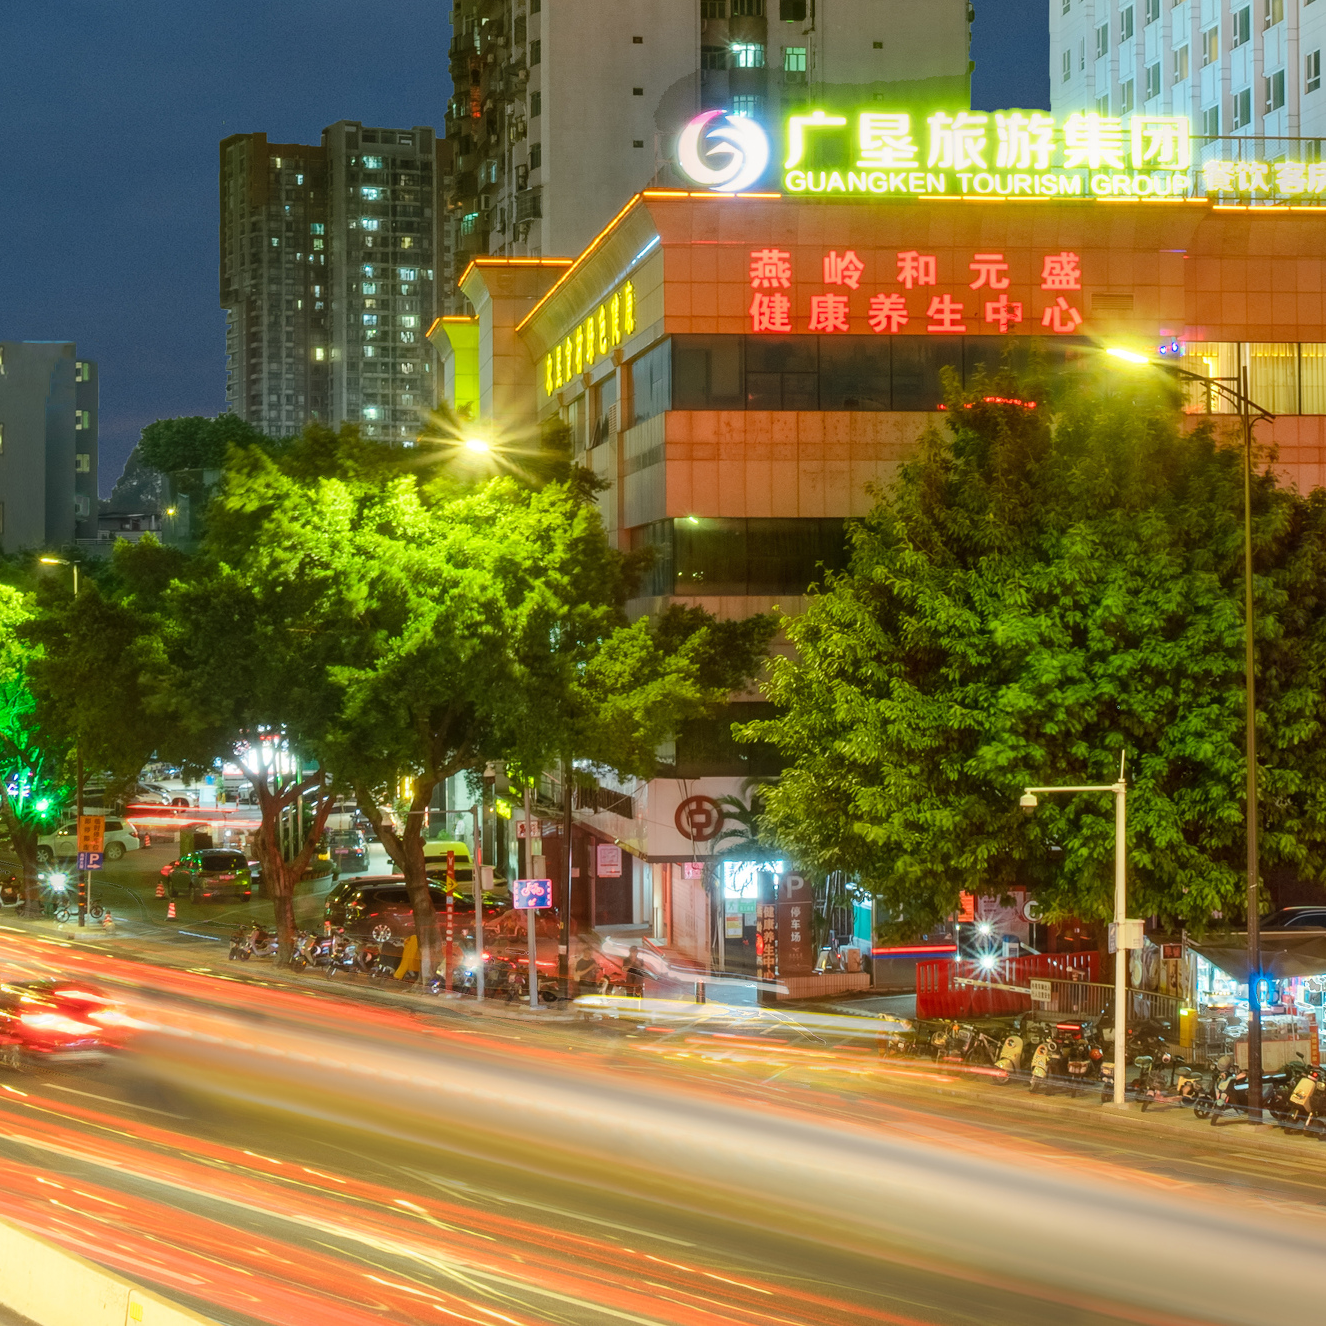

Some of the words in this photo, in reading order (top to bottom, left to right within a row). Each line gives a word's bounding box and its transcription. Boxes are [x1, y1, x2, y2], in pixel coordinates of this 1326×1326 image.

[784, 110, 1190, 170] 广垦旅游集团
[784, 171, 947, 193] GUANGKEN
[956, 172, 1081, 195] TOURISM
[1090, 173, 1191, 197] GROUP
[1203, 160, 1270, 193] 餐饮
[749, 249, 1082, 290] 燕岭和元盛
[749, 293, 1083, 334] 健康养生中心
[89, 853, 100, 864] P
[786, 875, 804, 898] P
[762, 905, 776, 980] 健康养生中心
[790, 906, 801, 943] 停车场
